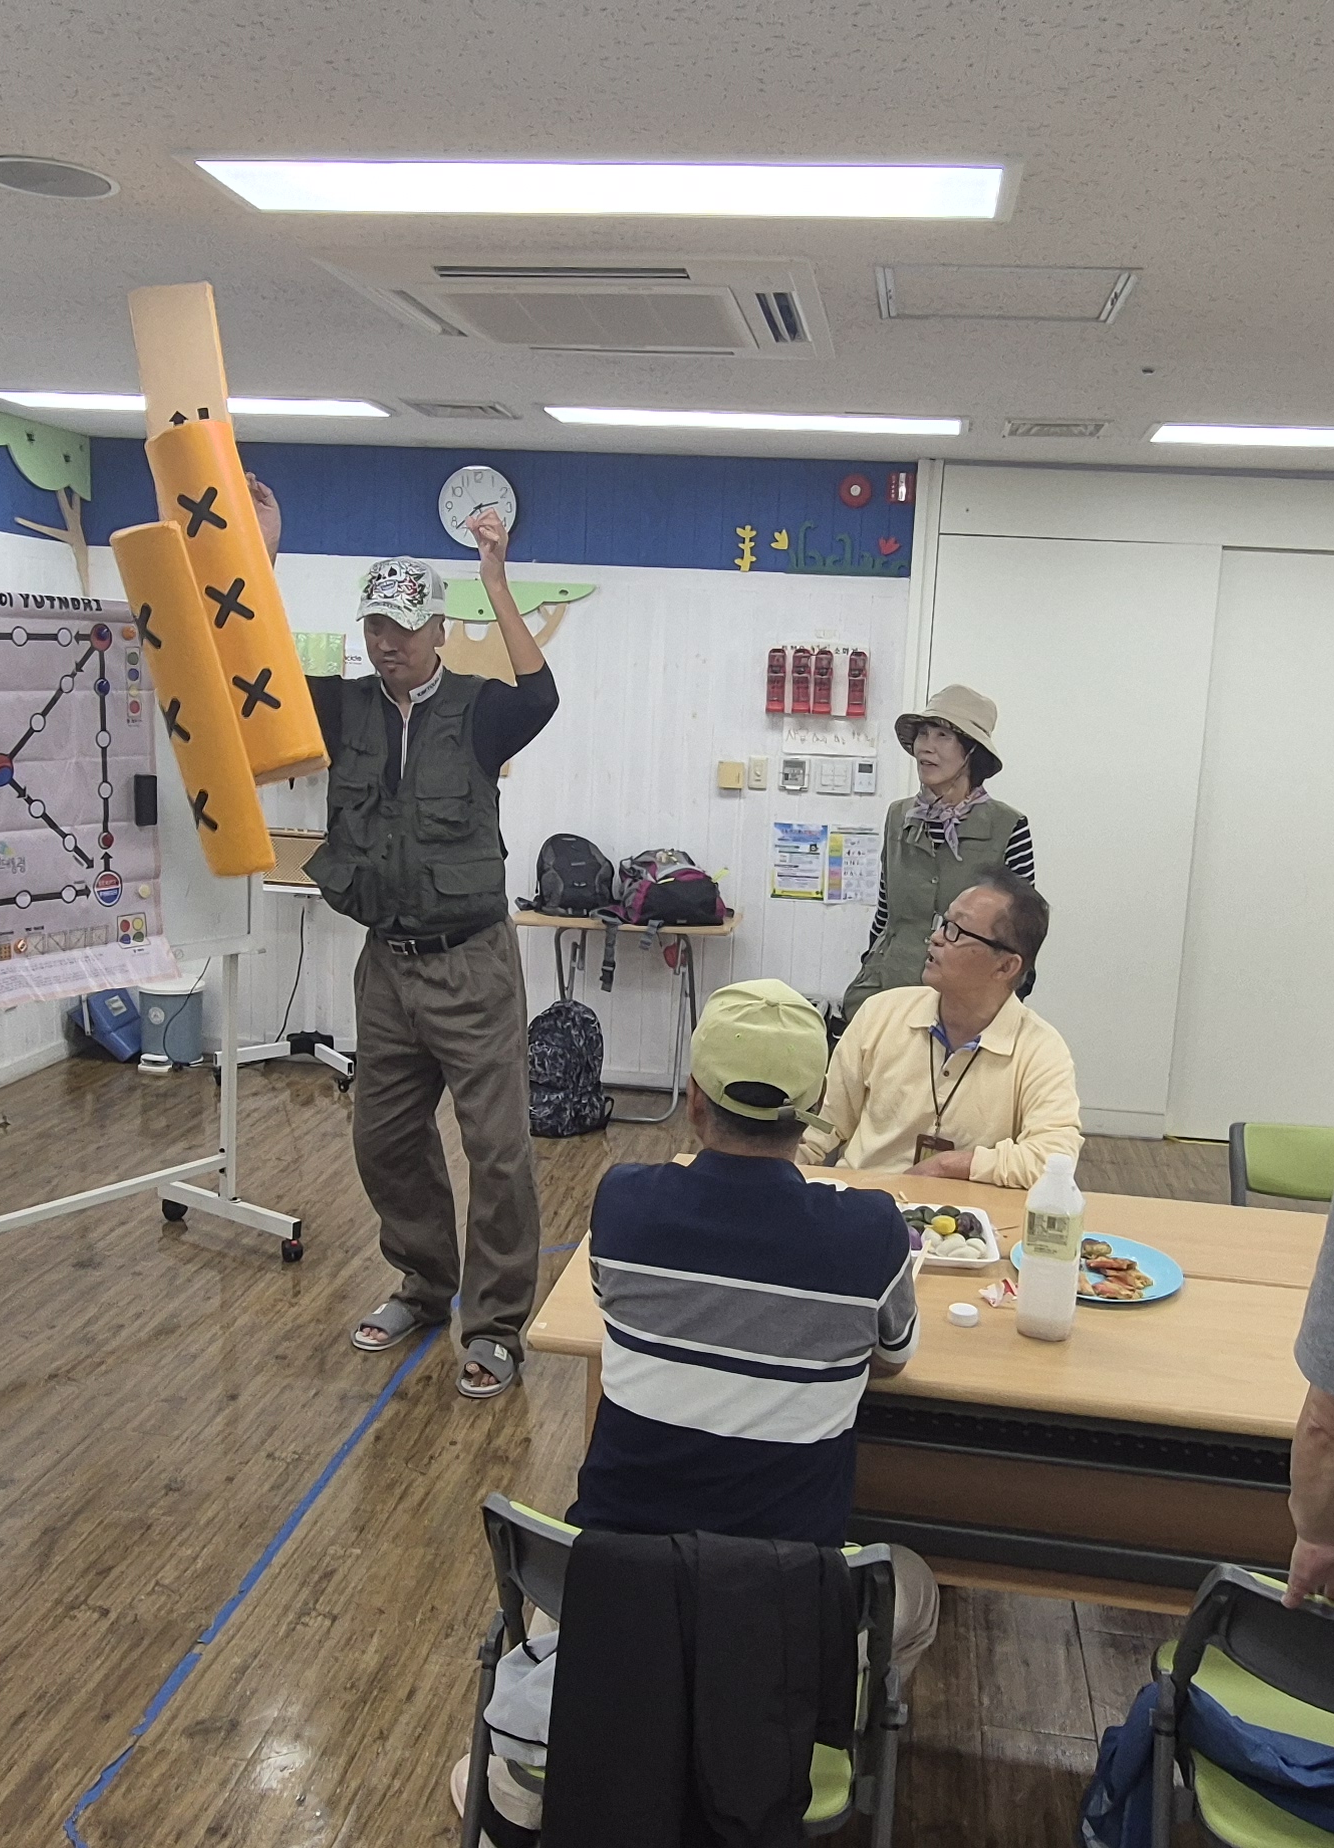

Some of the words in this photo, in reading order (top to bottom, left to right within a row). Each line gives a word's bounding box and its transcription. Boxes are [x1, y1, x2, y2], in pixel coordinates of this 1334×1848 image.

[461, 475, 470, 487] 11
[451, 486, 464, 497] 10
[500, 487, 508, 498] 2
[445, 501, 453, 512] 9
[505, 501, 513, 513] 3
[451, 516, 457, 528] 8
[17, 593, 104, 612] YUTNORI
